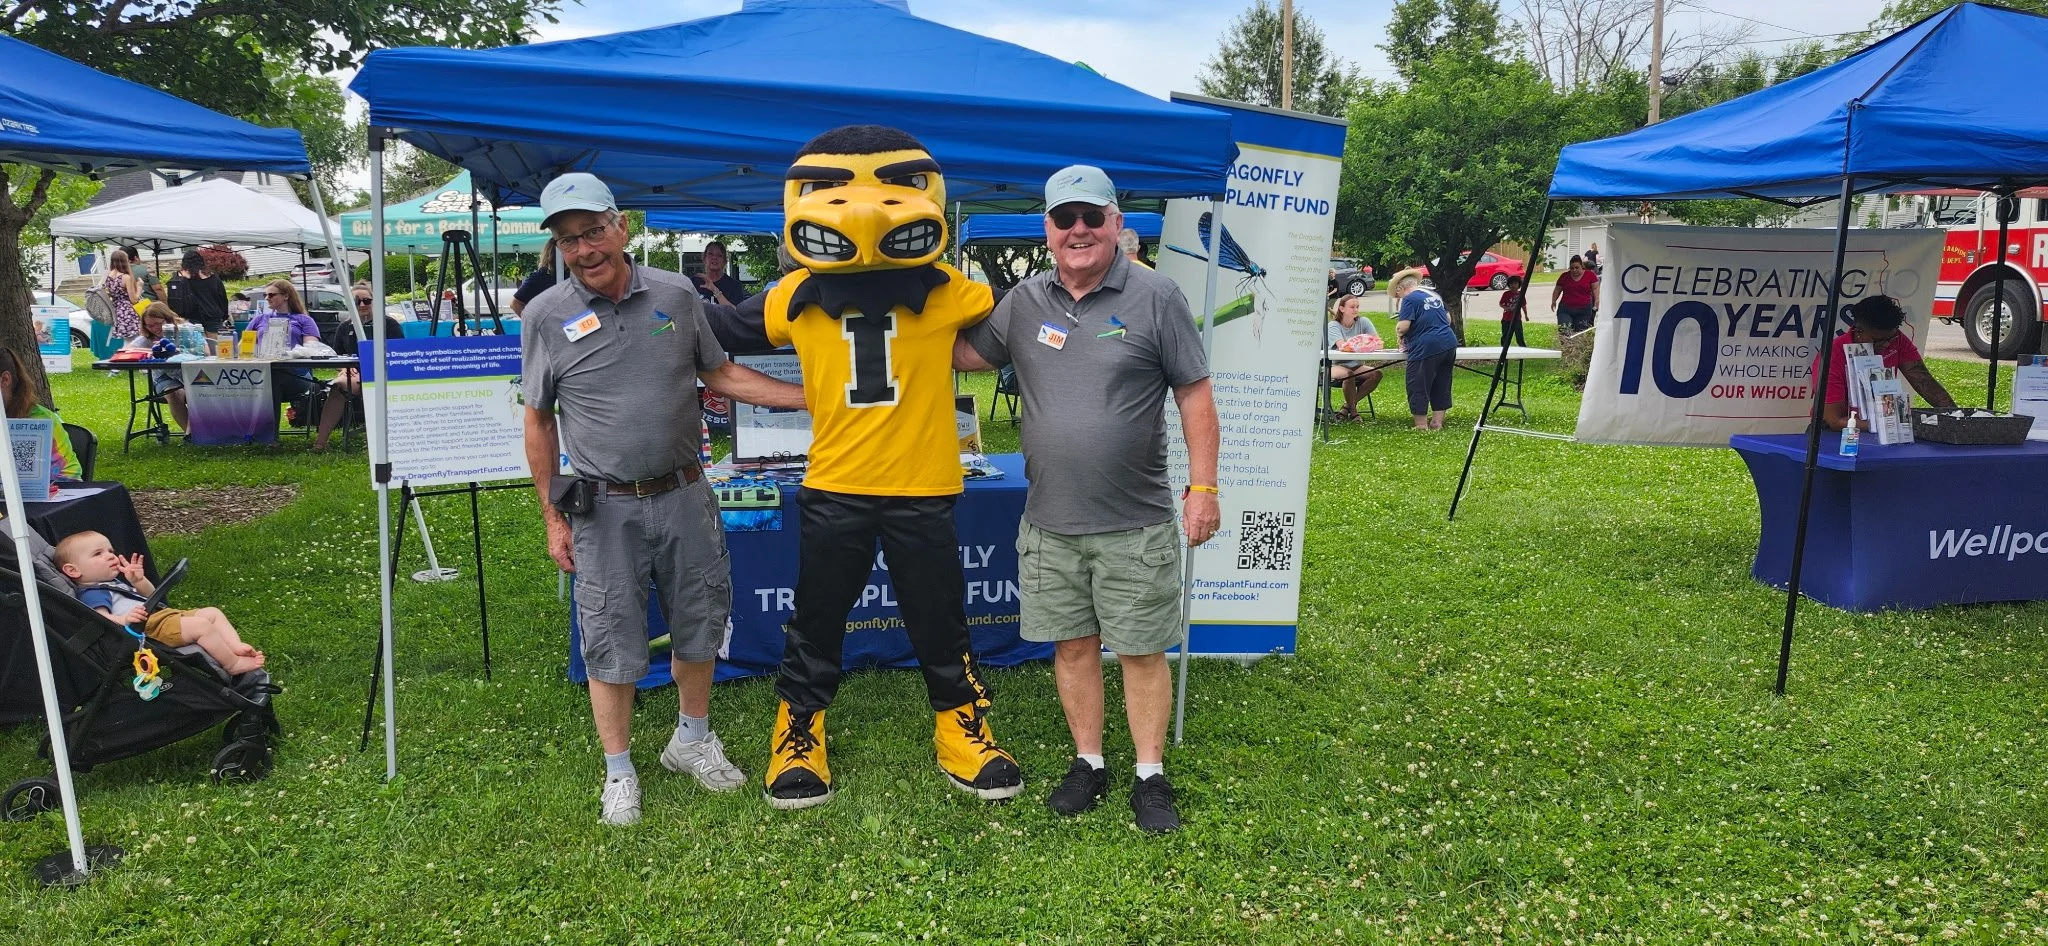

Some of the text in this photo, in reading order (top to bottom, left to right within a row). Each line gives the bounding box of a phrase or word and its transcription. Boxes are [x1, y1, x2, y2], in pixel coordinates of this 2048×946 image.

[1226, 163, 1304, 187] AGONFLY
[1283, 198, 1329, 216] FUND
[395, 219, 421, 235] for
[424, 222, 434, 236] a
[1947, 246, 1966, 257] RAPIDS
[1621, 263, 1867, 298] CELEBRATING
[581, 318, 593, 329] ED
[1048, 333, 1064, 345] JIM
[391, 350, 424, 358] Dragonfly
[425, 348, 462, 357] symbolizes
[463, 347, 487, 356] change
[501, 346, 521, 354] chang
[1613, 300, 1720, 399] 10
[1721, 345, 1741, 357] OF
[1746, 345, 1809, 358] MAKING
[390, 357, 429, 366] perspective
[842, 312, 899, 408] I
[427, 364, 450, 372] deeper
[451, 363, 480, 371] meaning
[1719, 364, 1777, 378] WHOLE
[217, 369, 264, 386] ASAC
[1216, 370, 1251, 381] provide
[1254, 374, 1289, 384] support
[387, 389, 493, 402] HE DRAGONFLY FUND
[1243, 385, 1264, 395] their
[1266, 386, 1301, 398] families
[1711, 384, 1745, 399] OUR
[1750, 385, 1807, 399] WHOLE
[1226, 398, 1251, 407] strive
[1253, 400, 1262, 408] to
[1264, 399, 1288, 411] bring
[1217, 411, 1280, 424] alue of organ
[1236, 425, 1247, 434] all
[1249, 426, 1281, 436] donors
[1222, 437, 1250, 447] Funds
[1252, 438, 1274, 448] from
[1275, 441, 1291, 449] our
[393, 465, 521, 481] ww.DragonflyTransportFund.com
[1233, 464, 1269, 475] hospital
[1178, 475, 1187, 484] to
[1236, 477, 1253, 486] and
[1256, 478, 1287, 488] friends
[1203, 542, 1219, 550] this
[1198, 592, 1210, 600] on
[1212, 591, 1259, 601] Facebook!
